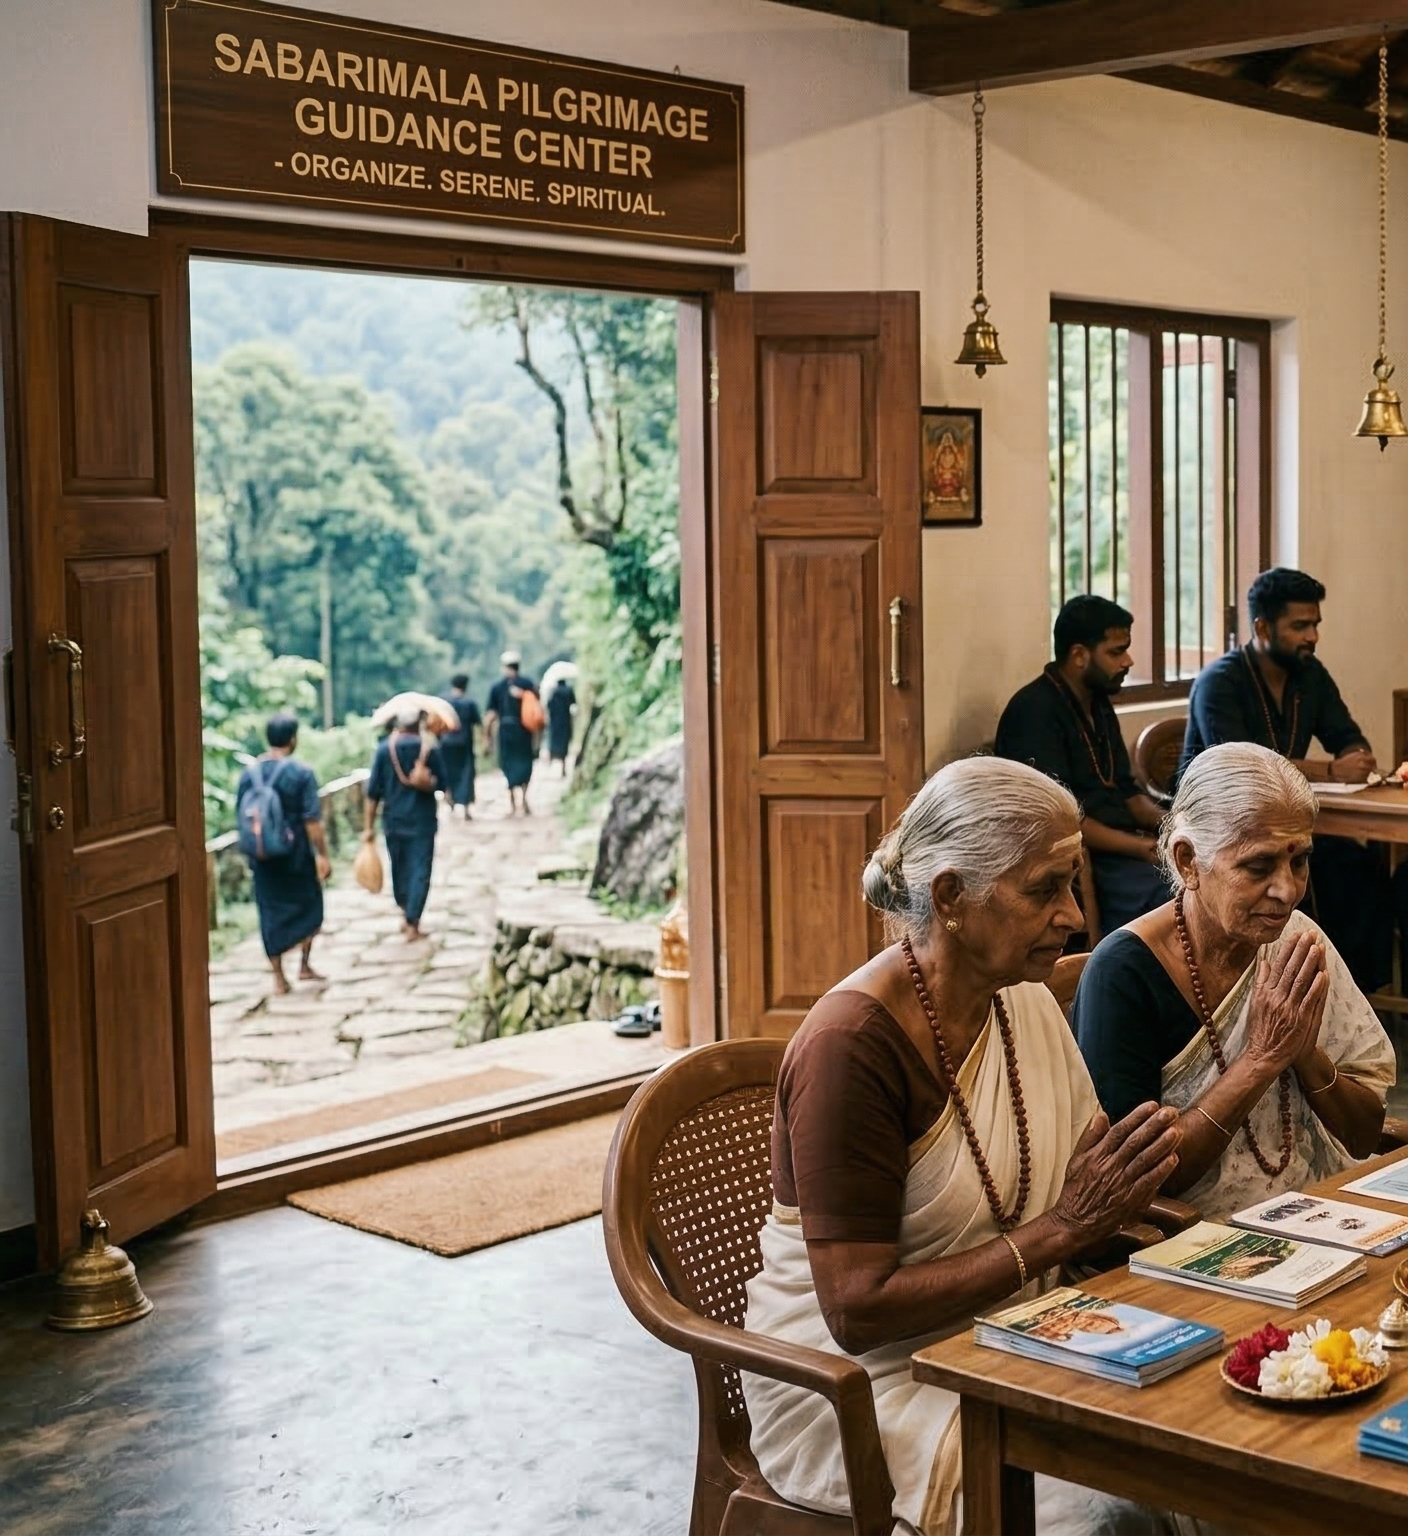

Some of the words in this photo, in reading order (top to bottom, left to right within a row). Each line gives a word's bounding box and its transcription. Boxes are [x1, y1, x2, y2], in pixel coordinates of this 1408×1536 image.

[214, 33, 488, 110] SABARIMALA
[498, 77, 708, 142] PILGRIMAGE
[295, 97, 502, 159] GUIDANCE
[514, 128, 653, 178] CENTER
[291, 151, 432, 190] ORGANIZE.
[440, 169, 541, 203] SERENE.
[547, 182, 666, 217] SPIRITUAL.
